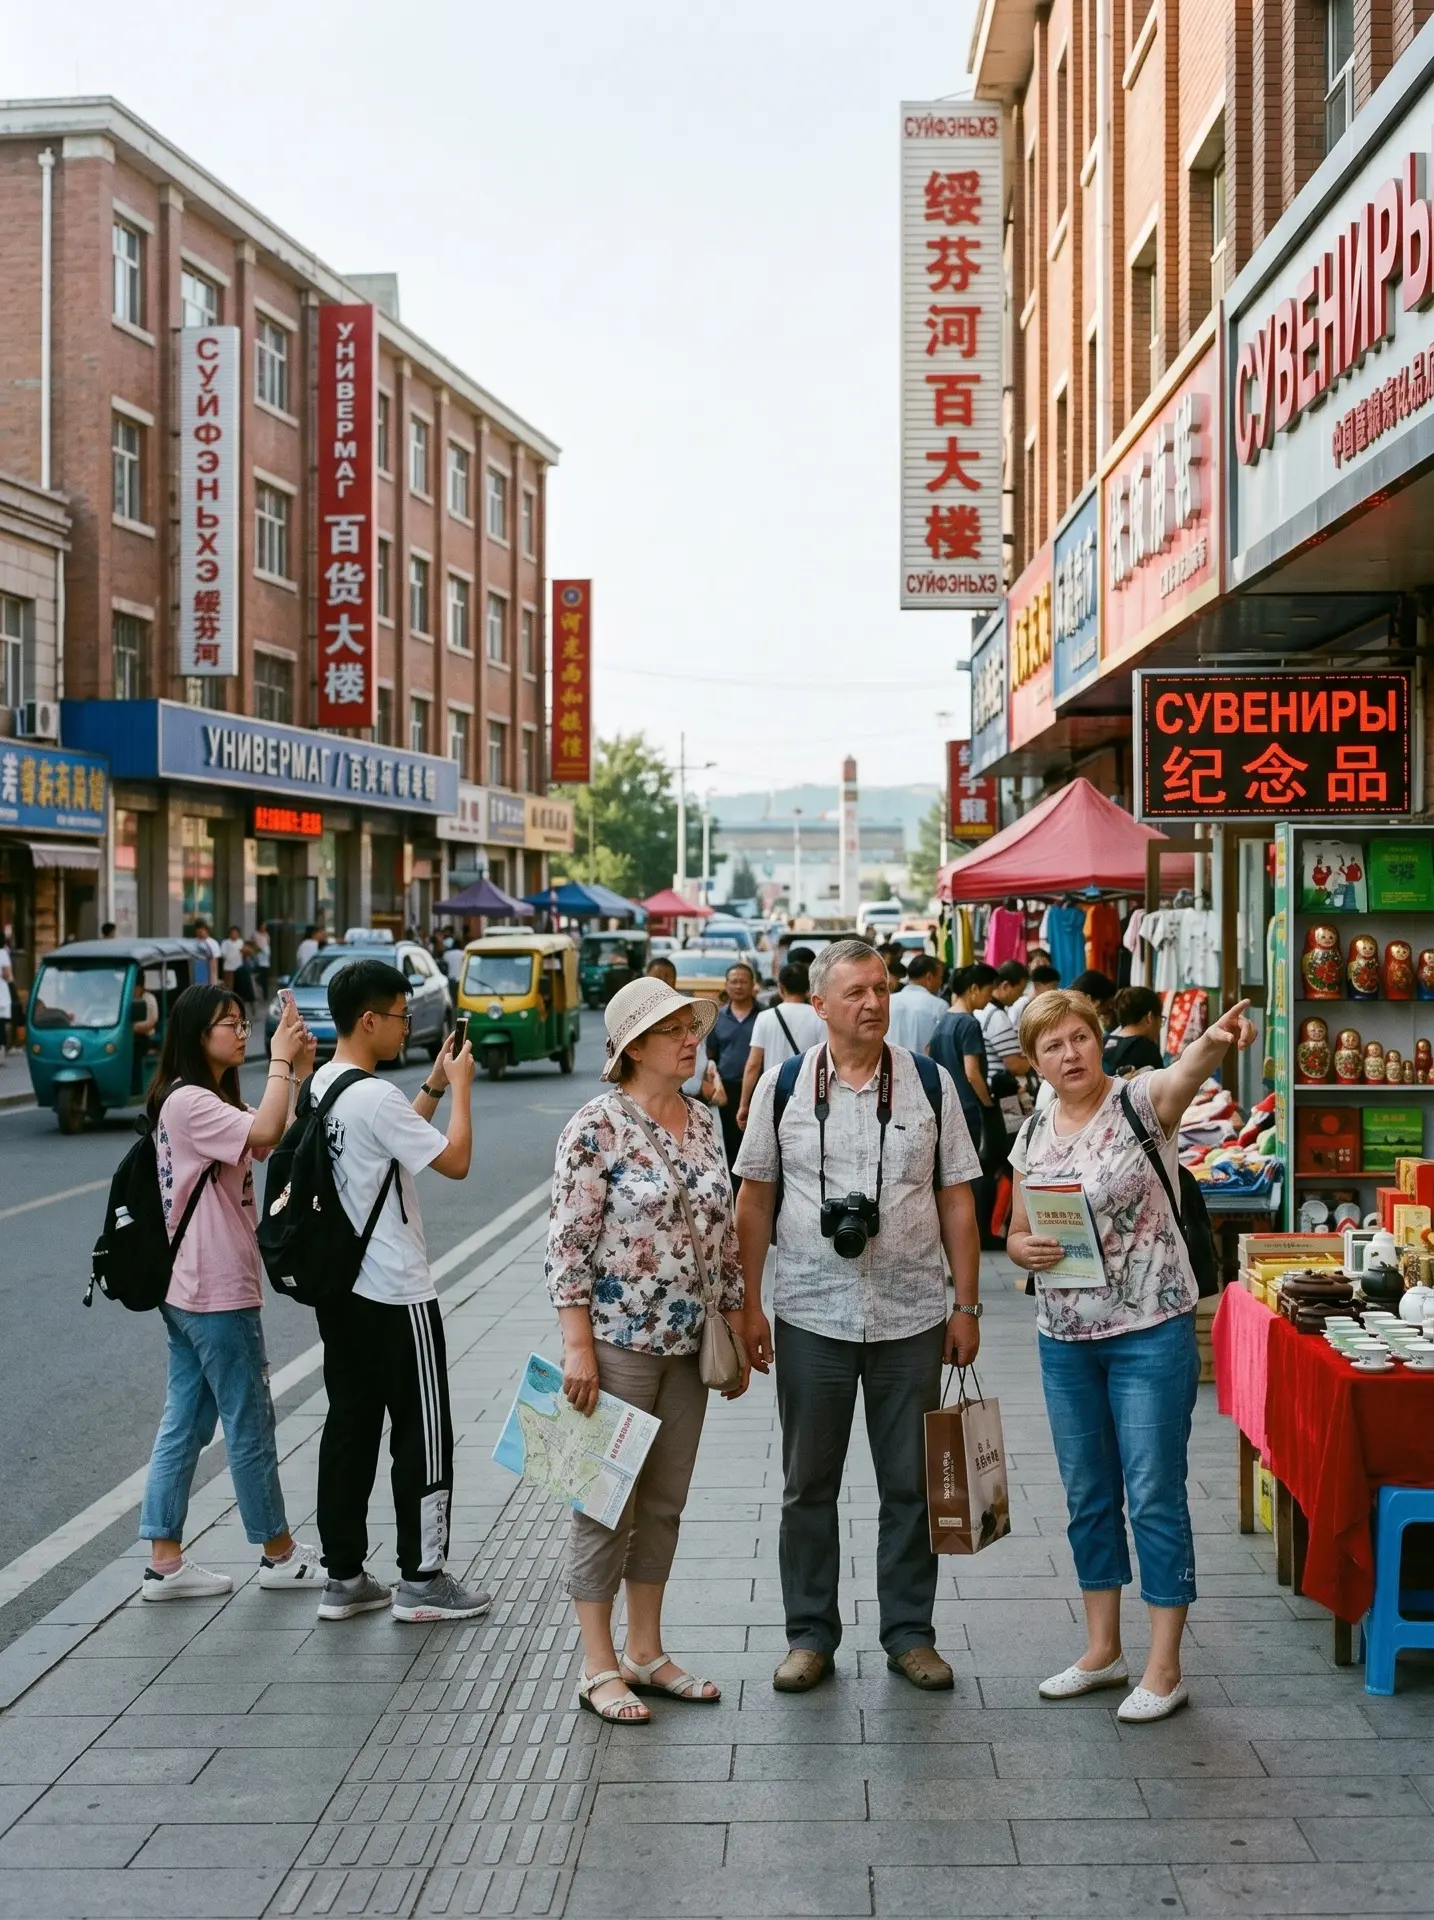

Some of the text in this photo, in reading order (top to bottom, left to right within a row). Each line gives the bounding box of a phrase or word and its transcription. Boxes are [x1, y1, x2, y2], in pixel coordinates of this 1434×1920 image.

[904, 112, 998, 137] СУЙФЭНЬХЭ
[924, 169, 982, 561] 绥芬河百大楼
[334, 322, 357, 498] УНИВЕРМАГ
[194, 338, 222, 583] СУЙФЭНЬХЭ
[324, 514, 366, 704] 百货大楼
[906, 570, 998, 593] СУЙФЭНЬХЭ
[1155, 690, 1396, 734] СУВЕНИРЫ
[206, 725, 331, 784] УНИВЕРМАГ
[1162, 742, 1387, 804] 纪念品
